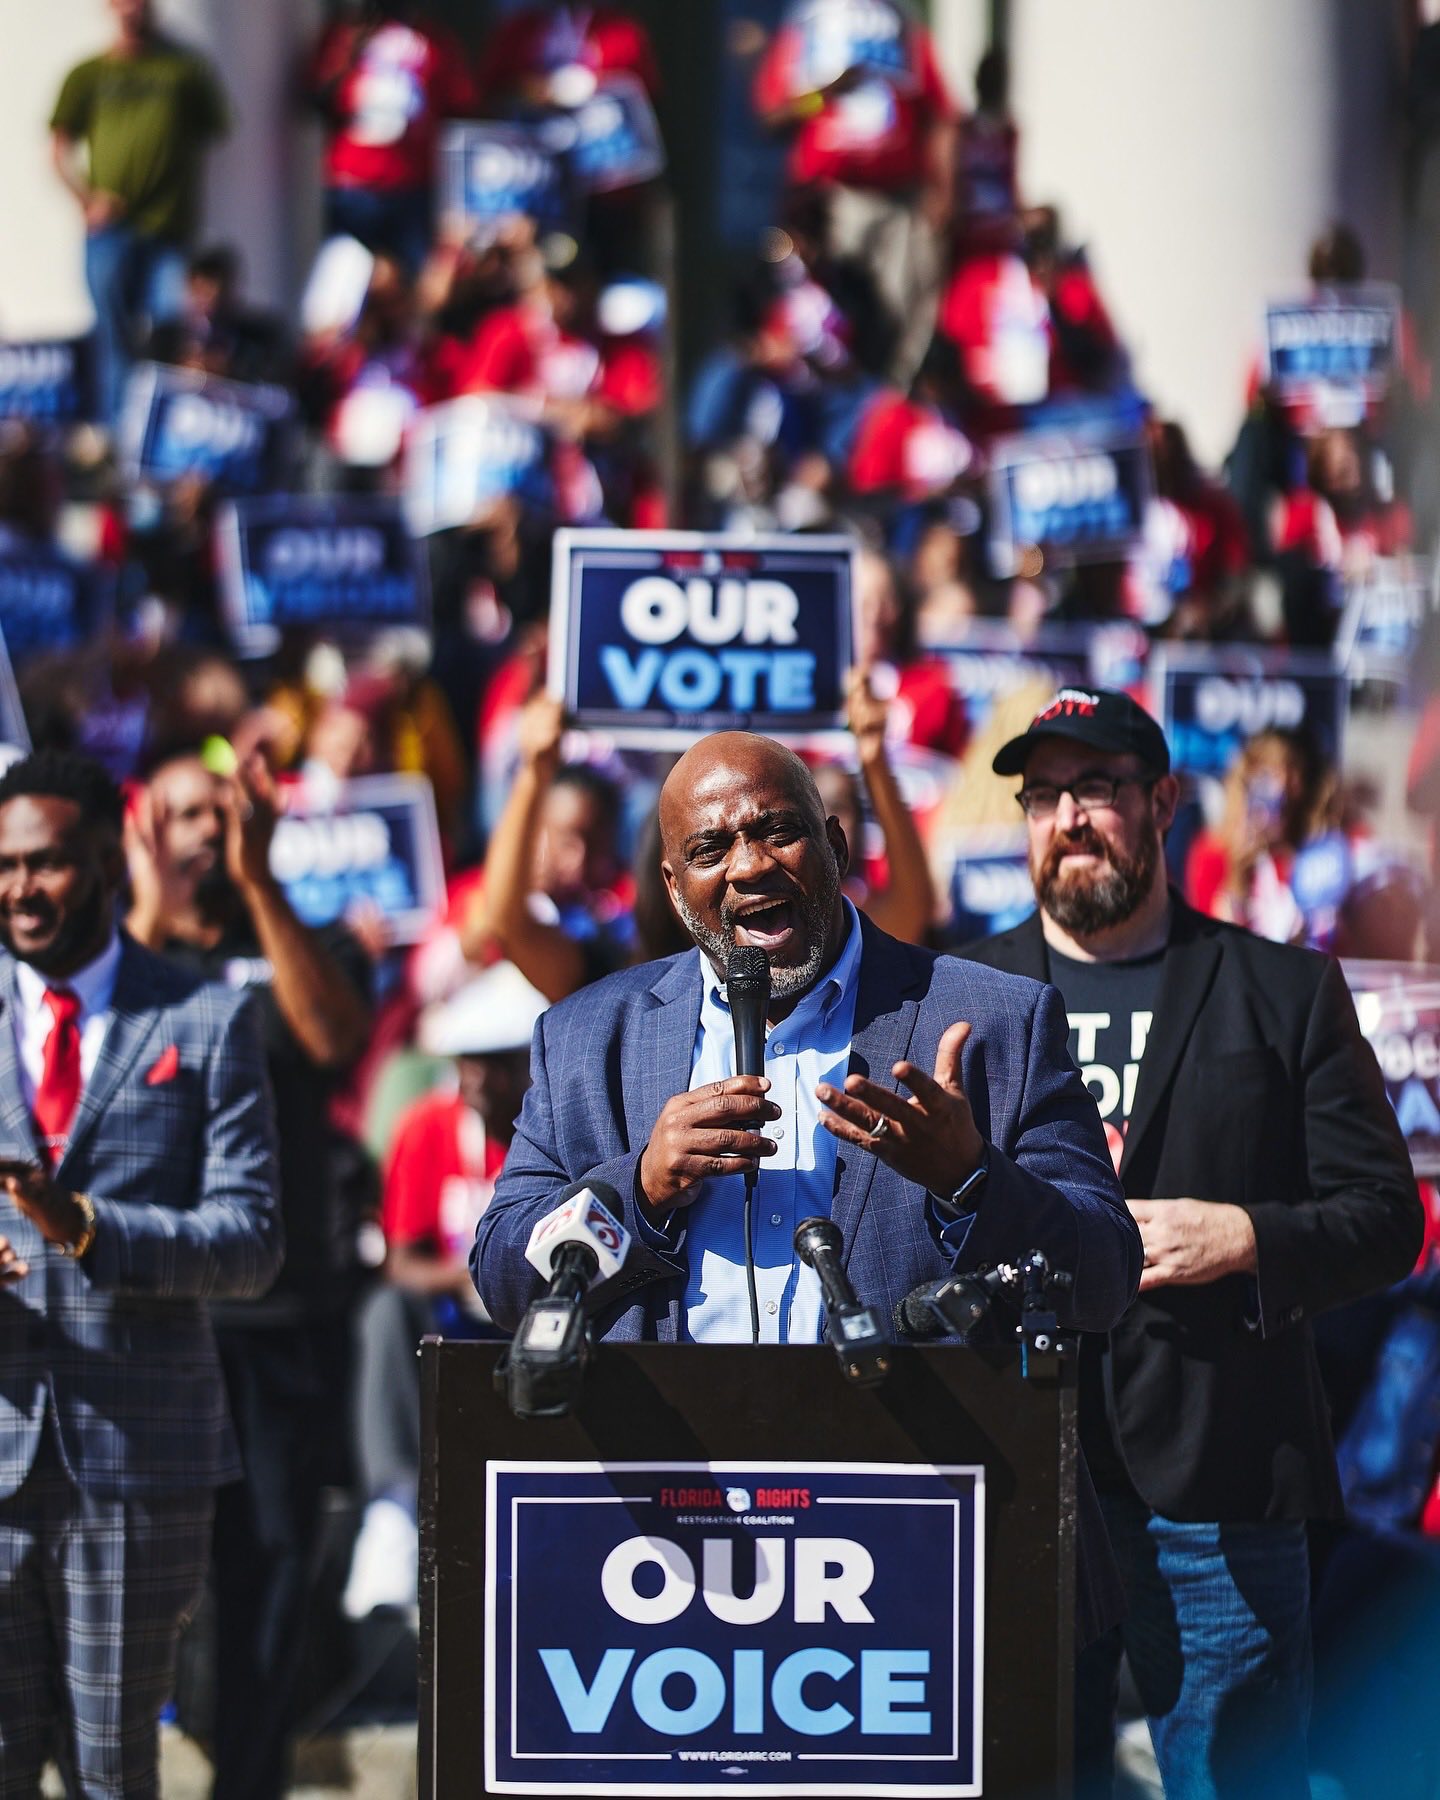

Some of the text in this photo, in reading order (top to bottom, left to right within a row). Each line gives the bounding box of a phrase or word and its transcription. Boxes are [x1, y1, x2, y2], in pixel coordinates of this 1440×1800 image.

[620, 576, 800, 645] OUR
[600, 646, 817, 713] VOTE
[660, 1488, 811, 1508] FLORIDA RIGHTS
[676, 1515, 795, 1525] RESTORATION COALITION
[601, 1535, 875, 1625] OUR
[537, 1647, 932, 1736] VOICE
